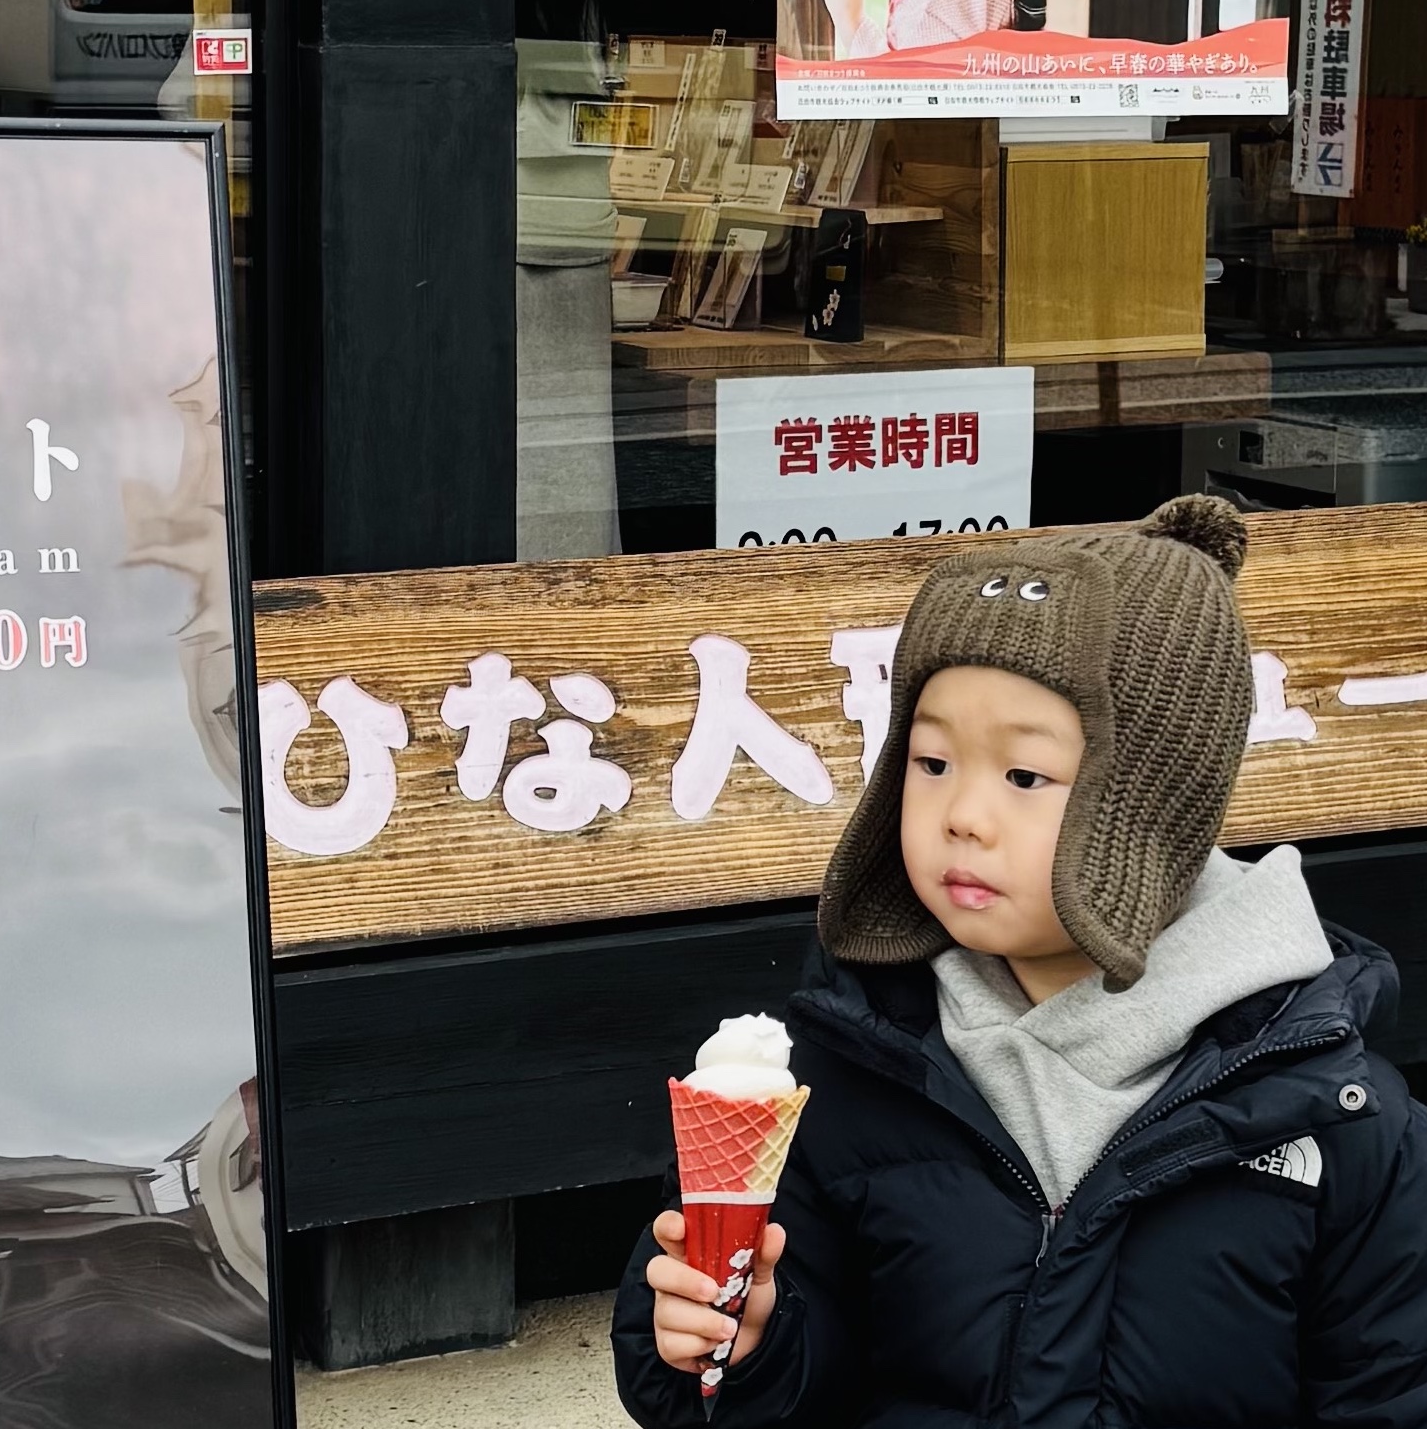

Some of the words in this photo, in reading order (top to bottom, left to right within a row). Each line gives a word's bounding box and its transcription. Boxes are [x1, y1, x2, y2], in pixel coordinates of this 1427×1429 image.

[962, 51, 1259, 77] 九州の山あいに、早春の華やぎあり。
[773, 411, 980, 477] 営業時間
